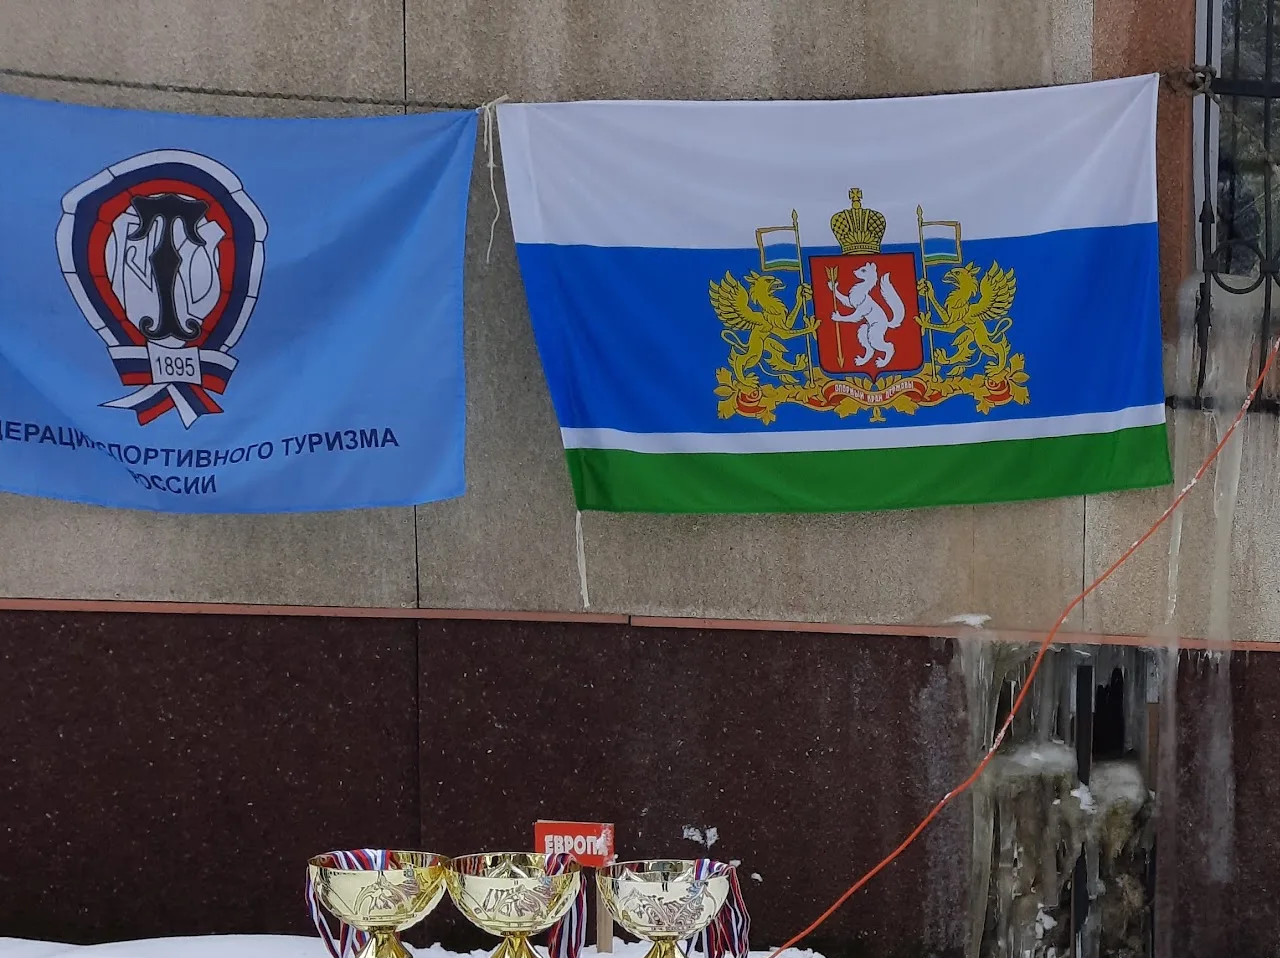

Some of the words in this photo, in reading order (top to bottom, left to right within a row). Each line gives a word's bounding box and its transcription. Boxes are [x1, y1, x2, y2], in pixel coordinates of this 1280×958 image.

[155, 356, 195, 376] 1895
[0, 420, 96, 450] ЕРАЦИ
[281, 427, 399, 457] ТУРИЗМА
